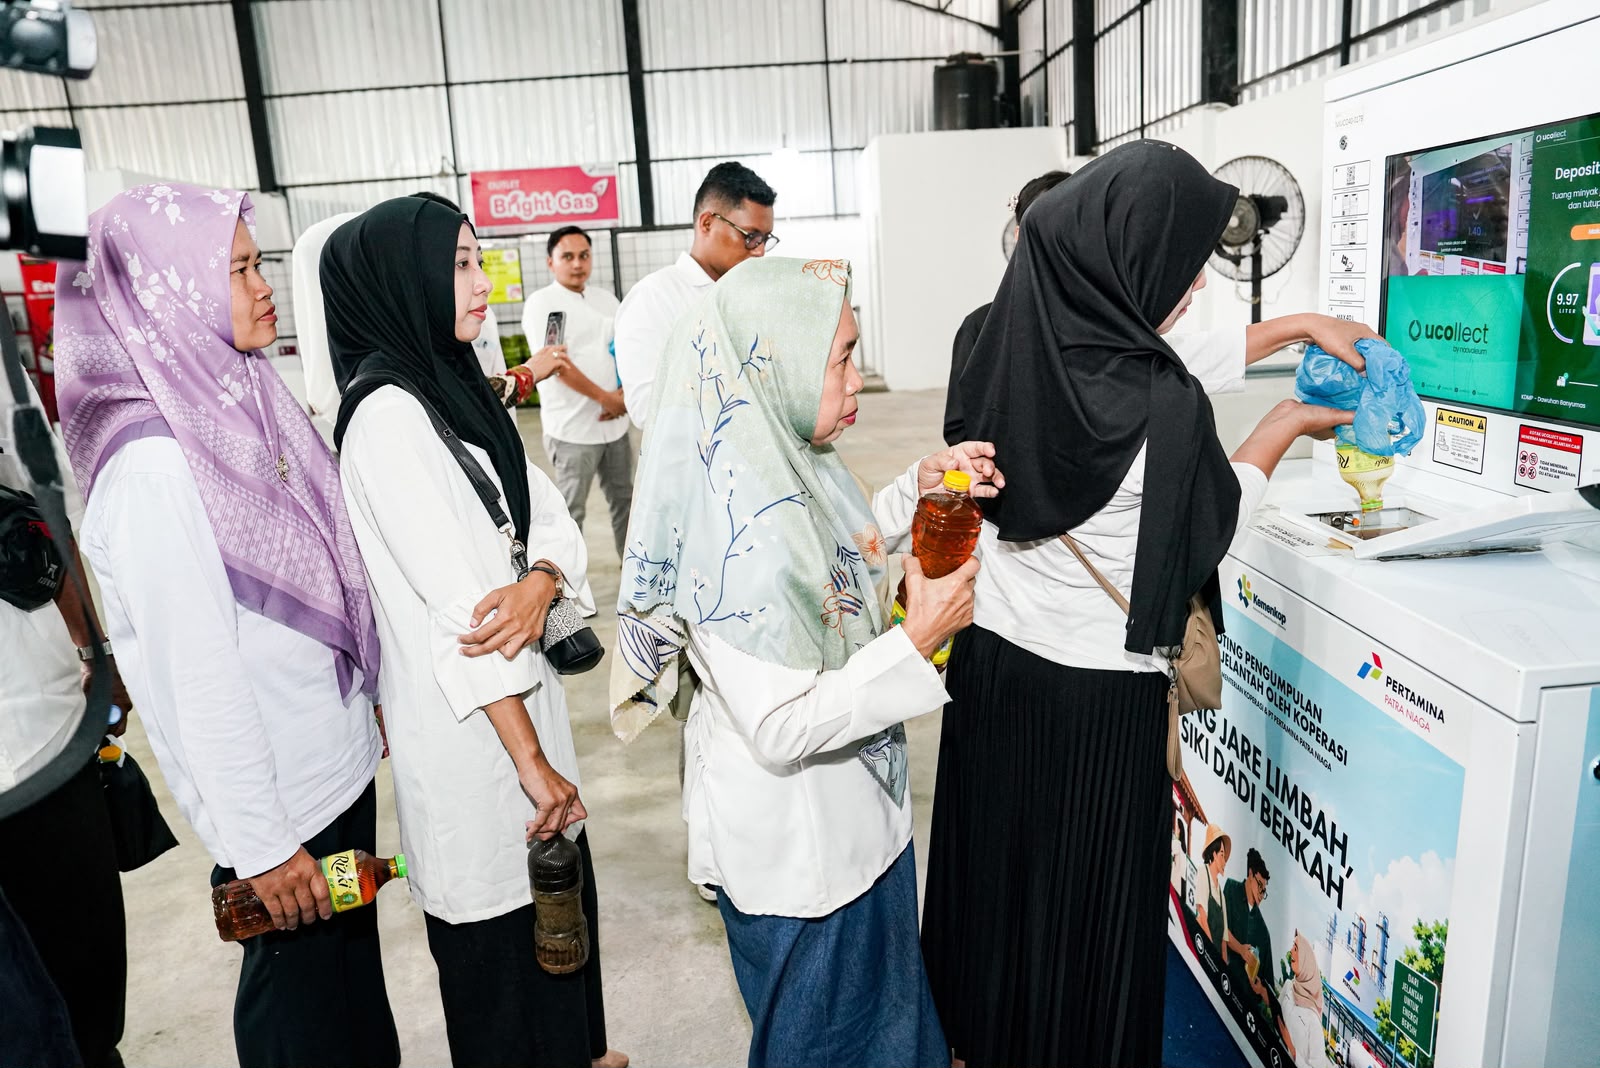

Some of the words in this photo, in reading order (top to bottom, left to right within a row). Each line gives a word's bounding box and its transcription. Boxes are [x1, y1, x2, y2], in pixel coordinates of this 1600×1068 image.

[1555, 161, 1600, 182] Deposit
[492, 191, 553, 218] Bright
[557, 191, 596, 212] Gas
[1552, 191, 1572, 200] Tuang
[1573, 187, 1598, 198] minyak
[1568, 201, 1582, 210] dan
[1556, 293, 1578, 306] 9.97
[1425, 322, 1488, 344] ucollect
[1448, 416, 1474, 426] CAUTION
[1253, 594, 1287, 626] Kemenkop
[1217, 634, 1243, 660] OTING
[1245, 650, 1322, 723] PENGUMPULAN
[1221, 651, 1264, 696] JELANTAH
[1266, 683, 1291, 716] OLEH
[1293, 708, 1348, 766] KOPERASI
[1386, 676, 1445, 723] PERTAMINA
[1384, 695, 1404, 714] PATRA
[1406, 708, 1430, 732] NIAGA
[1220, 718, 1261, 780] JARE
[1274, 716, 1299, 742] PERTAMINA
[1299, 737, 1314, 756] PATRA
[1315, 750, 1332, 772] NIAGA
[1181, 716, 1209, 765] SIKI
[1214, 746, 1256, 813] DADI
[1260, 792, 1344, 910] BERKAH
[331, 854, 354, 888] Rizki
[1408, 974, 1419, 987] DARI
[1402, 982, 1423, 1004] JELANTAH
[1402, 1006, 1418, 1025] ENERGI
[1404, 996, 1419, 1013] UNTUK
[1401, 1018, 1418, 1037] BERSIH
